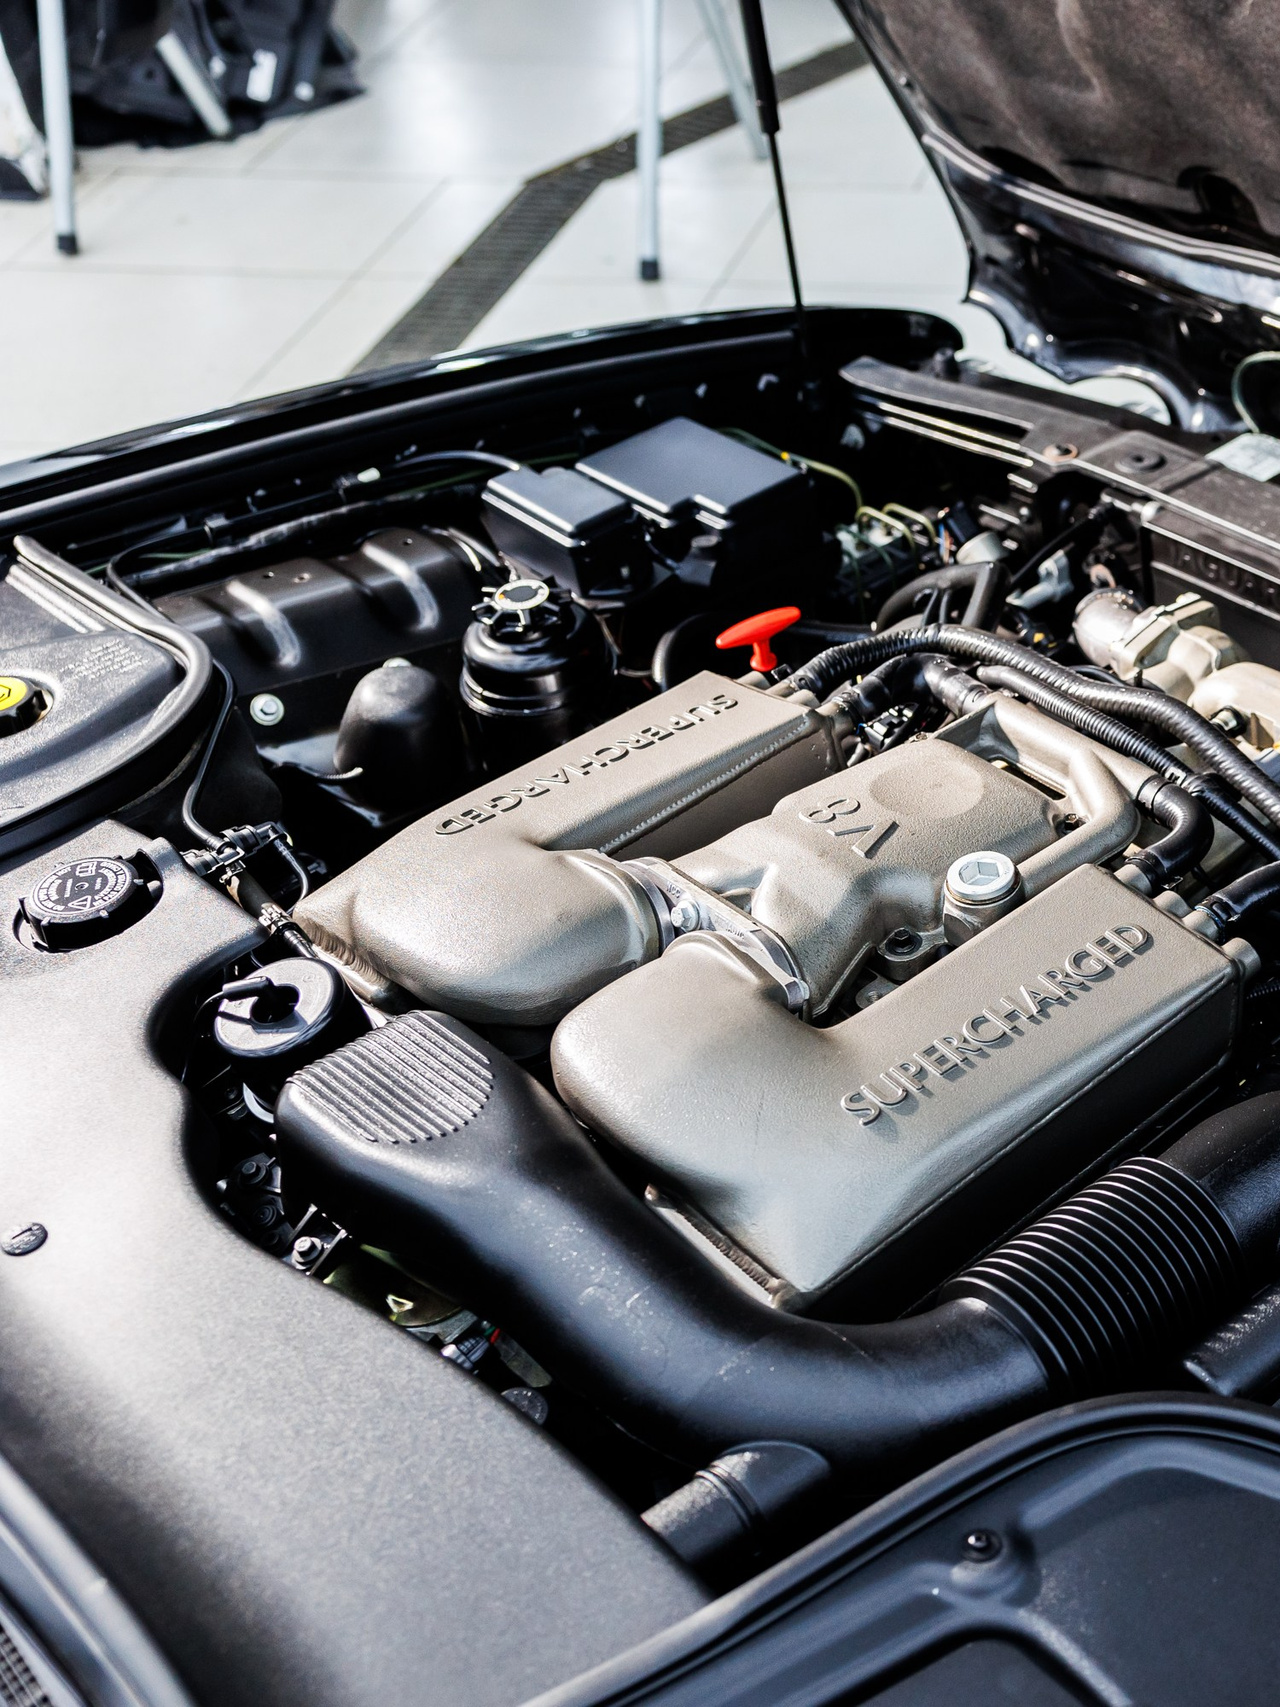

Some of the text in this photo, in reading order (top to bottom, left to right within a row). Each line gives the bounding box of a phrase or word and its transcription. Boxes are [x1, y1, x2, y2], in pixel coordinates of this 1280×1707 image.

[434, 694, 739, 836] SUPERCHARGED
[56, 866, 72, 877] HOT
[798, 798, 900, 860] V8
[840, 922, 1154, 1127] SUPERCHARGED
